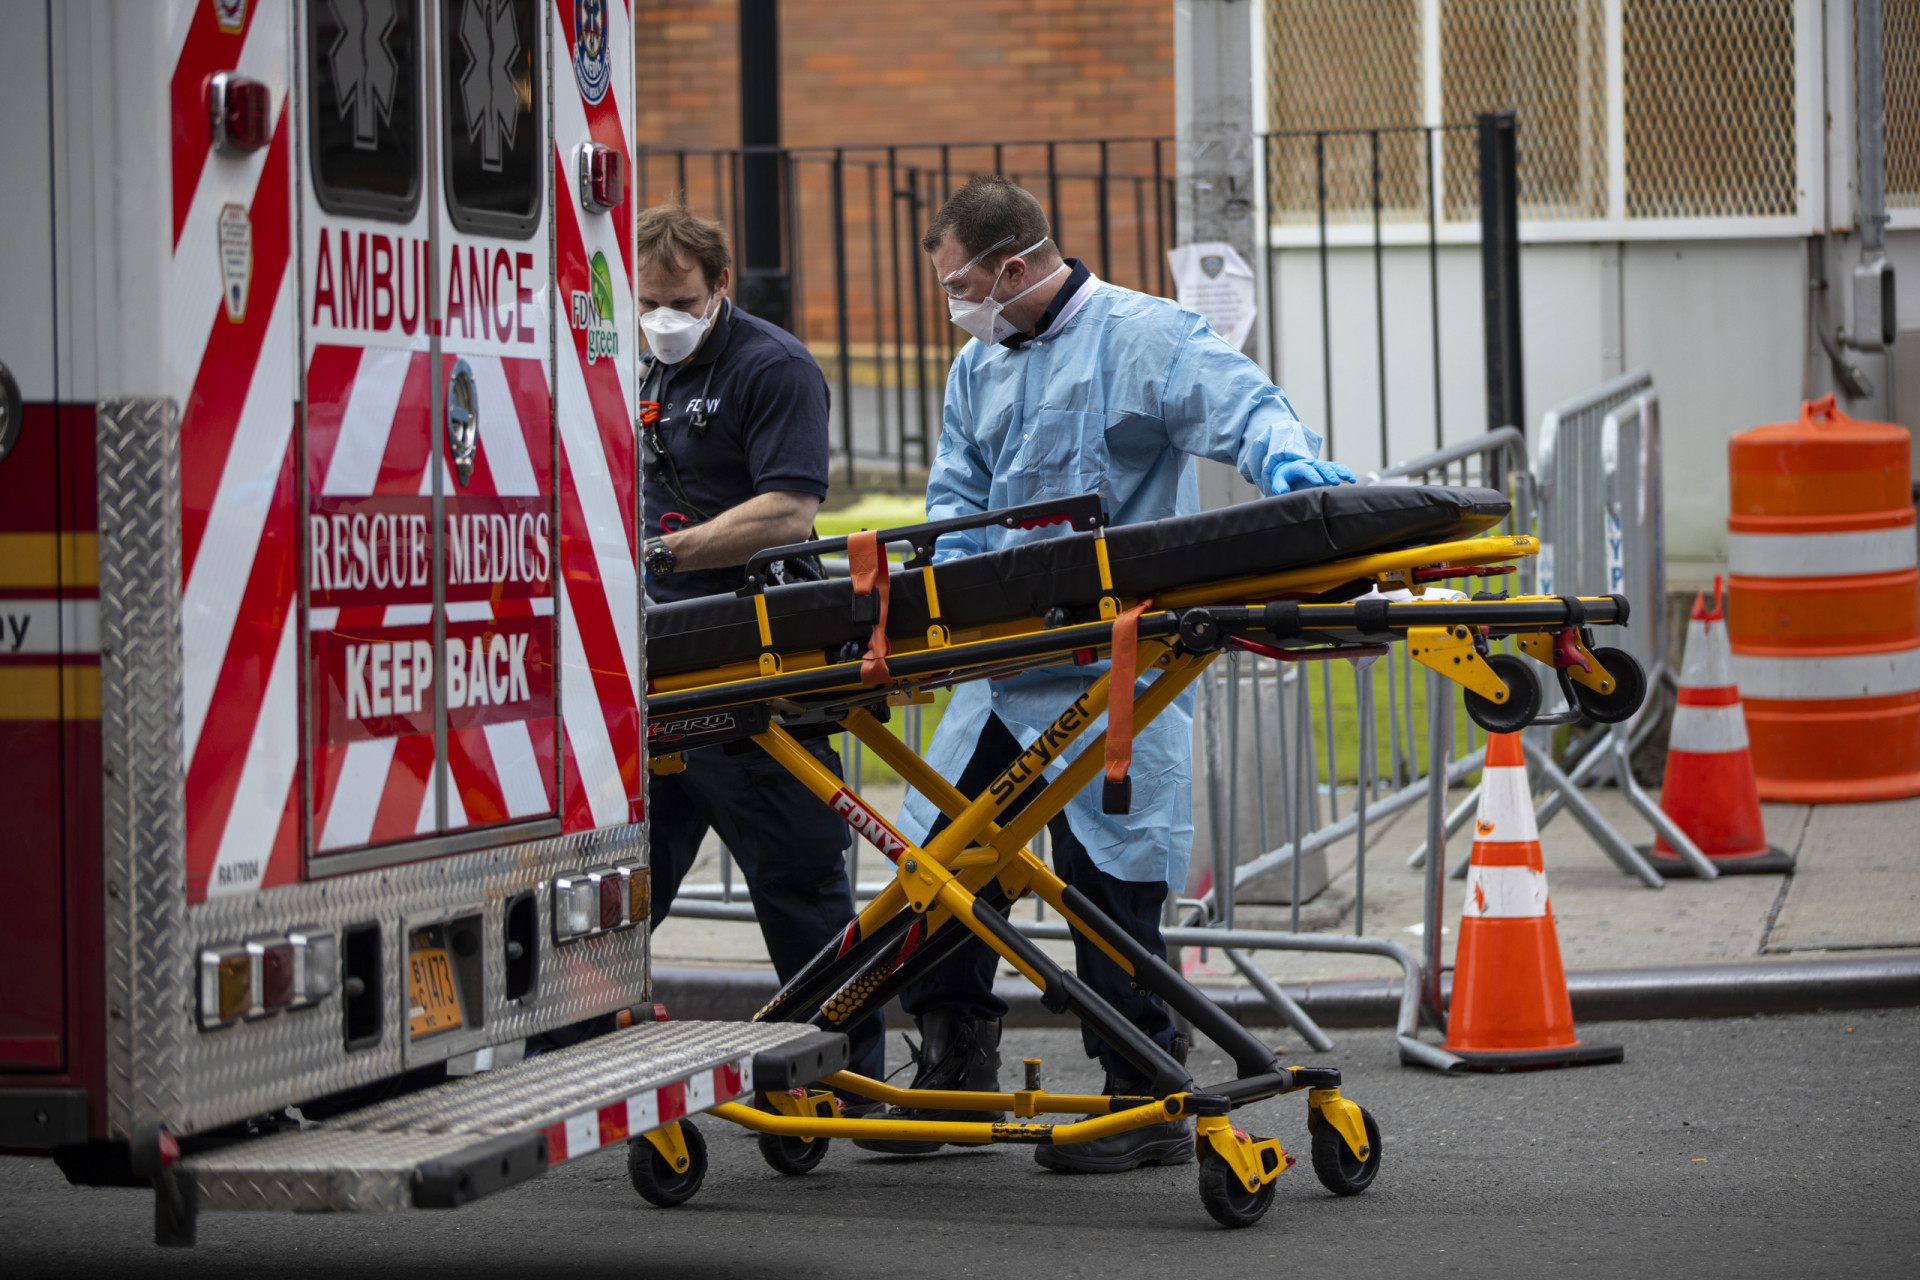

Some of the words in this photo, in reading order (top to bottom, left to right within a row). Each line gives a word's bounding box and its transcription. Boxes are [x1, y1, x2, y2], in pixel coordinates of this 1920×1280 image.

[312, 227, 535, 343] AMBULANCE
[573, 295, 604, 327] FDNY
[588, 329, 618, 361] green
[685, 398, 721, 414] FDNY
[310, 512, 428, 591] RESCUE
[448, 512, 549, 586] MEDICS
[346, 639, 433, 720] KEEP
[446, 633, 530, 709] BACK
[834, 796, 901, 856] FDNY
